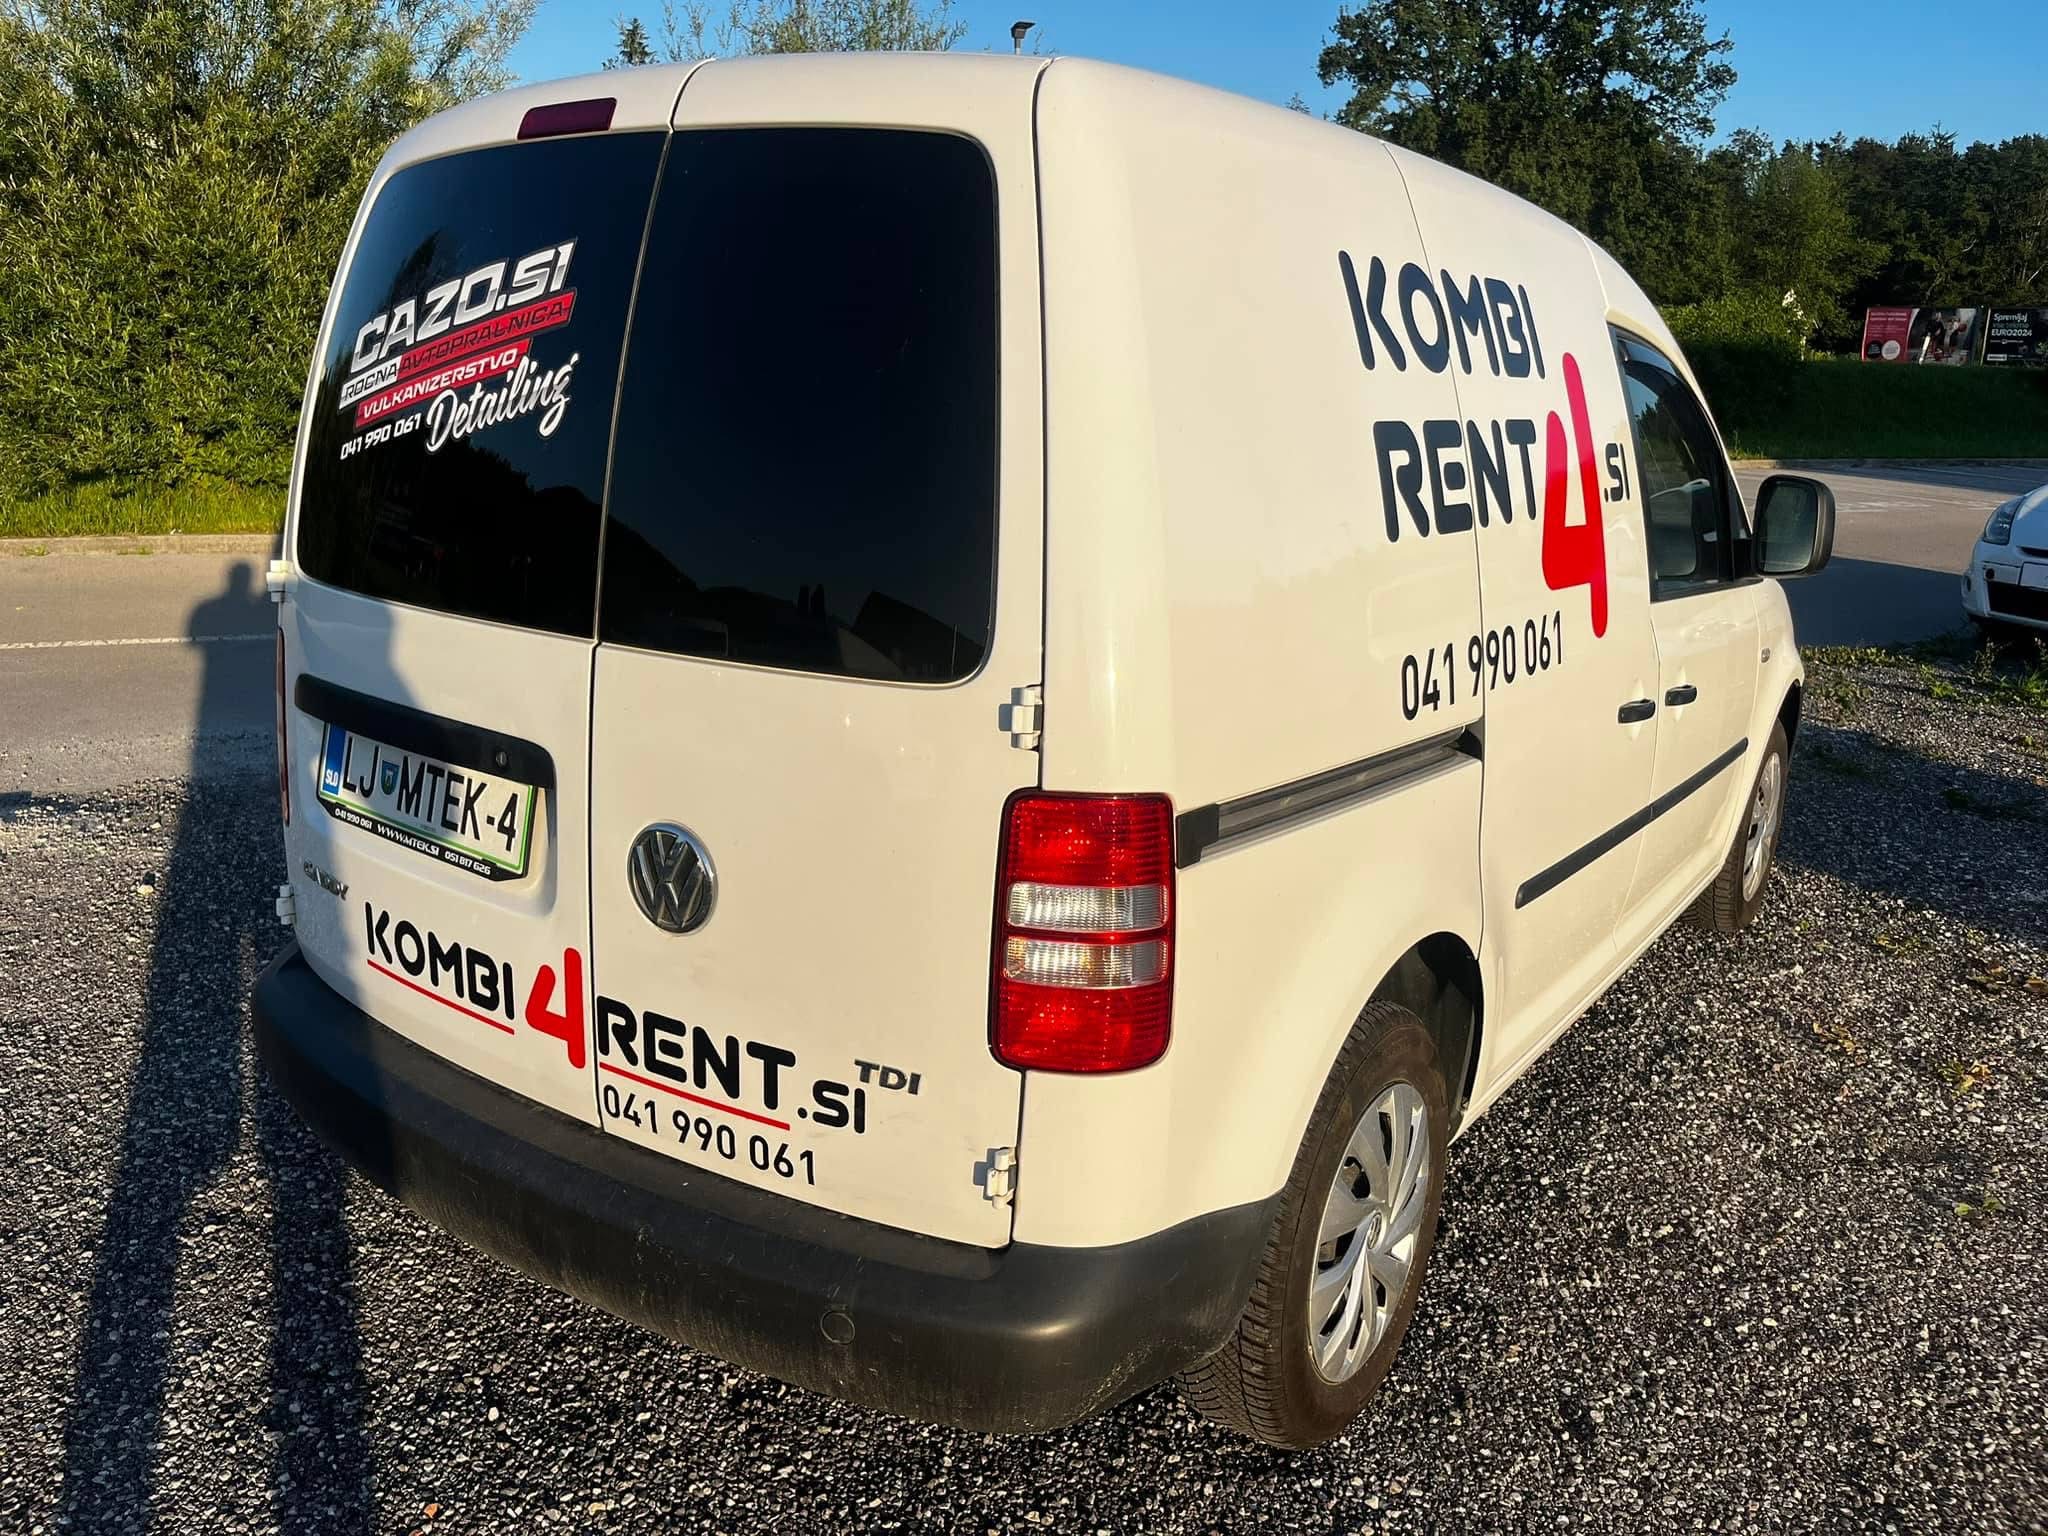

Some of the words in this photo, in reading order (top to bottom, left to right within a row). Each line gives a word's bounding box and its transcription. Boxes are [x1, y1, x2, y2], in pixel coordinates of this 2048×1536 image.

[400, 302, 564, 371] AVTOPRALNICA
[1338, 250, 1546, 379] KOMBI
[1991, 328, 2033, 337] EURO2024
[340, 436, 363, 460] 041
[364, 427, 391, 450] 990
[393, 413, 421, 438] 061
[426, 352, 579, 452] Detailing
[364, 348, 518, 418] VULKANIZERSTVO
[1373, 418, 1537, 543] RENT
[1542, 352, 1608, 639] 4
[1401, 642, 1455, 720] 041
[1467, 625, 1516, 697] 990
[1524, 610, 1563, 677] 061
[325, 770, 338, 783] SLO
[343, 736, 380, 799] LJ
[396, 755, 519, 852] MTEK-4
[334, 808, 346, 819] 041
[346, 813, 360, 825] 990
[360, 818, 373, 830] 061
[377, 823, 440, 856] WWW.MTEK.SI
[444, 850, 459, 863] 051
[459, 855, 473, 868] 817
[473, 861, 492, 876] 626
[364, 901, 515, 1021] KOMBI
[854, 1058, 921, 1095] TDI
[603, 1083, 659, 1135] 041
[672, 1110, 737, 1160] 990
[749, 1134, 816, 1186] 061
